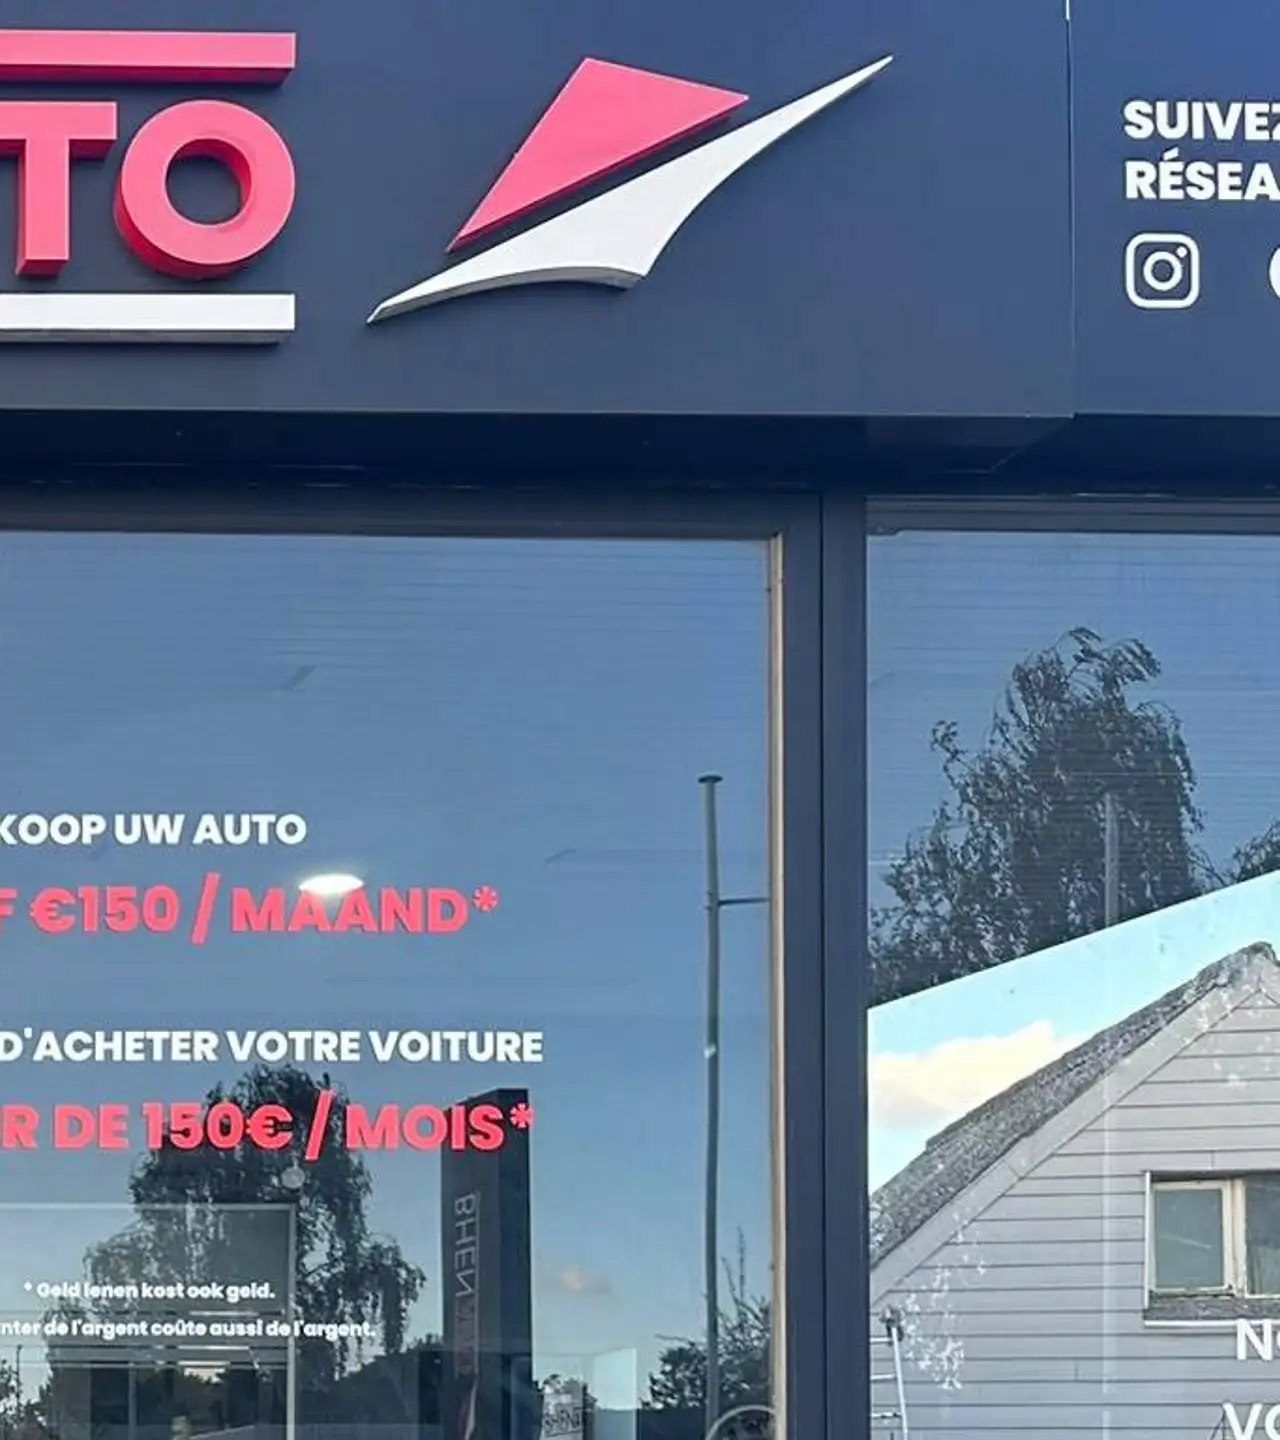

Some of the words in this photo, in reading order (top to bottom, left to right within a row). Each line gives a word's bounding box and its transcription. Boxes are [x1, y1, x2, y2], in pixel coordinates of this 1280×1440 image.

[1123, 100, 1280, 141] SUIVE
[114, 814, 186, 846] UW
[192, 814, 308, 846] AUTO
[29, 885, 179, 933] €150
[225, 1031, 360, 1063] VOTRE
[369, 1031, 543, 1064] VOITURE
[53, 1104, 130, 1151] DE
[143, 1103, 293, 1151] 150€
[37, 1281, 81, 1299] Geld
[142, 1282, 184, 1299] kost
[187, 1282, 225, 1299] ook
[44, 1319, 69, 1336] de
[151, 1319, 207, 1337] coûte
[266, 1318, 291, 1337] de
